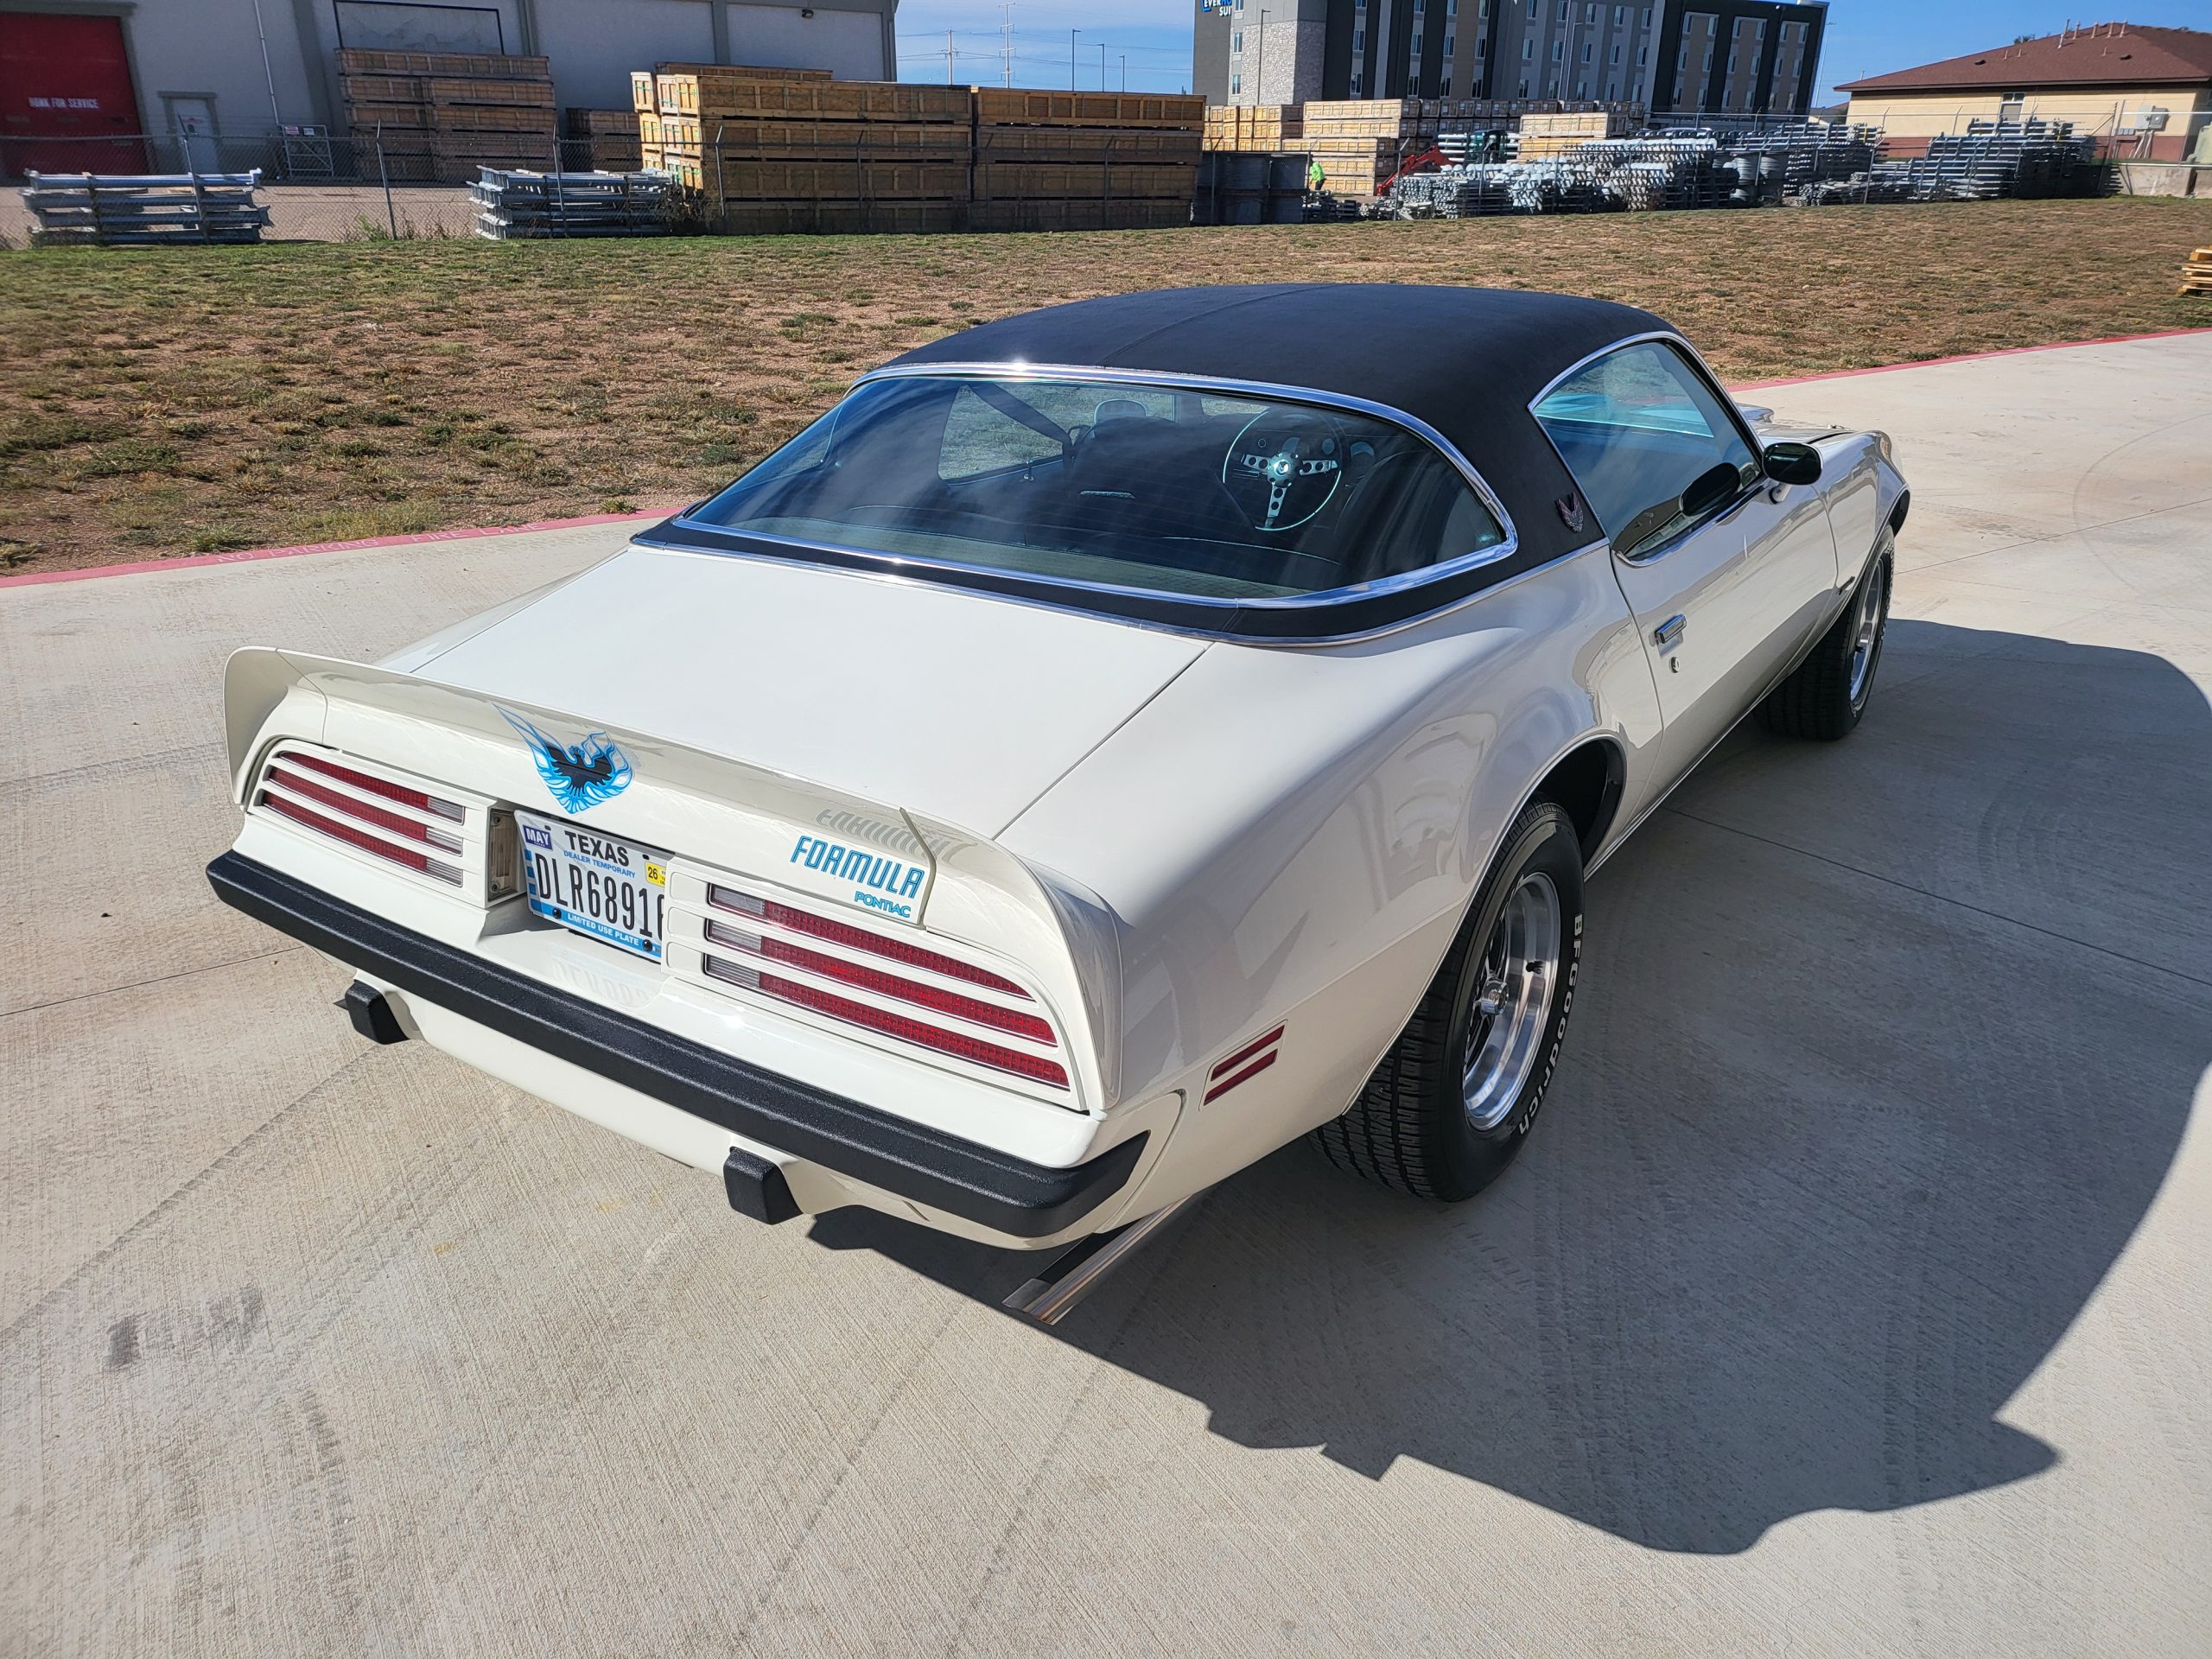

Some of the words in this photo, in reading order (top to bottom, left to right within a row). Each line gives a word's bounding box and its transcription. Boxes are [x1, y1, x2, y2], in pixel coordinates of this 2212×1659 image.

[51, 97, 67, 109] FOR
[68, 98, 99, 110] SERVICE
[525, 827, 550, 846] MAY
[564, 830, 630, 867] TEXAS
[563, 849, 592, 864] DEALER
[592, 858, 636, 879] TEMPORARY
[647, 866, 658, 880] 26
[790, 835, 925, 899] FORMULA
[854, 890, 912, 918] PONTIAC
[567, 912, 596, 930] LIMITED
[597, 921, 613, 937] USE
[614, 930, 639, 946] PLATE
